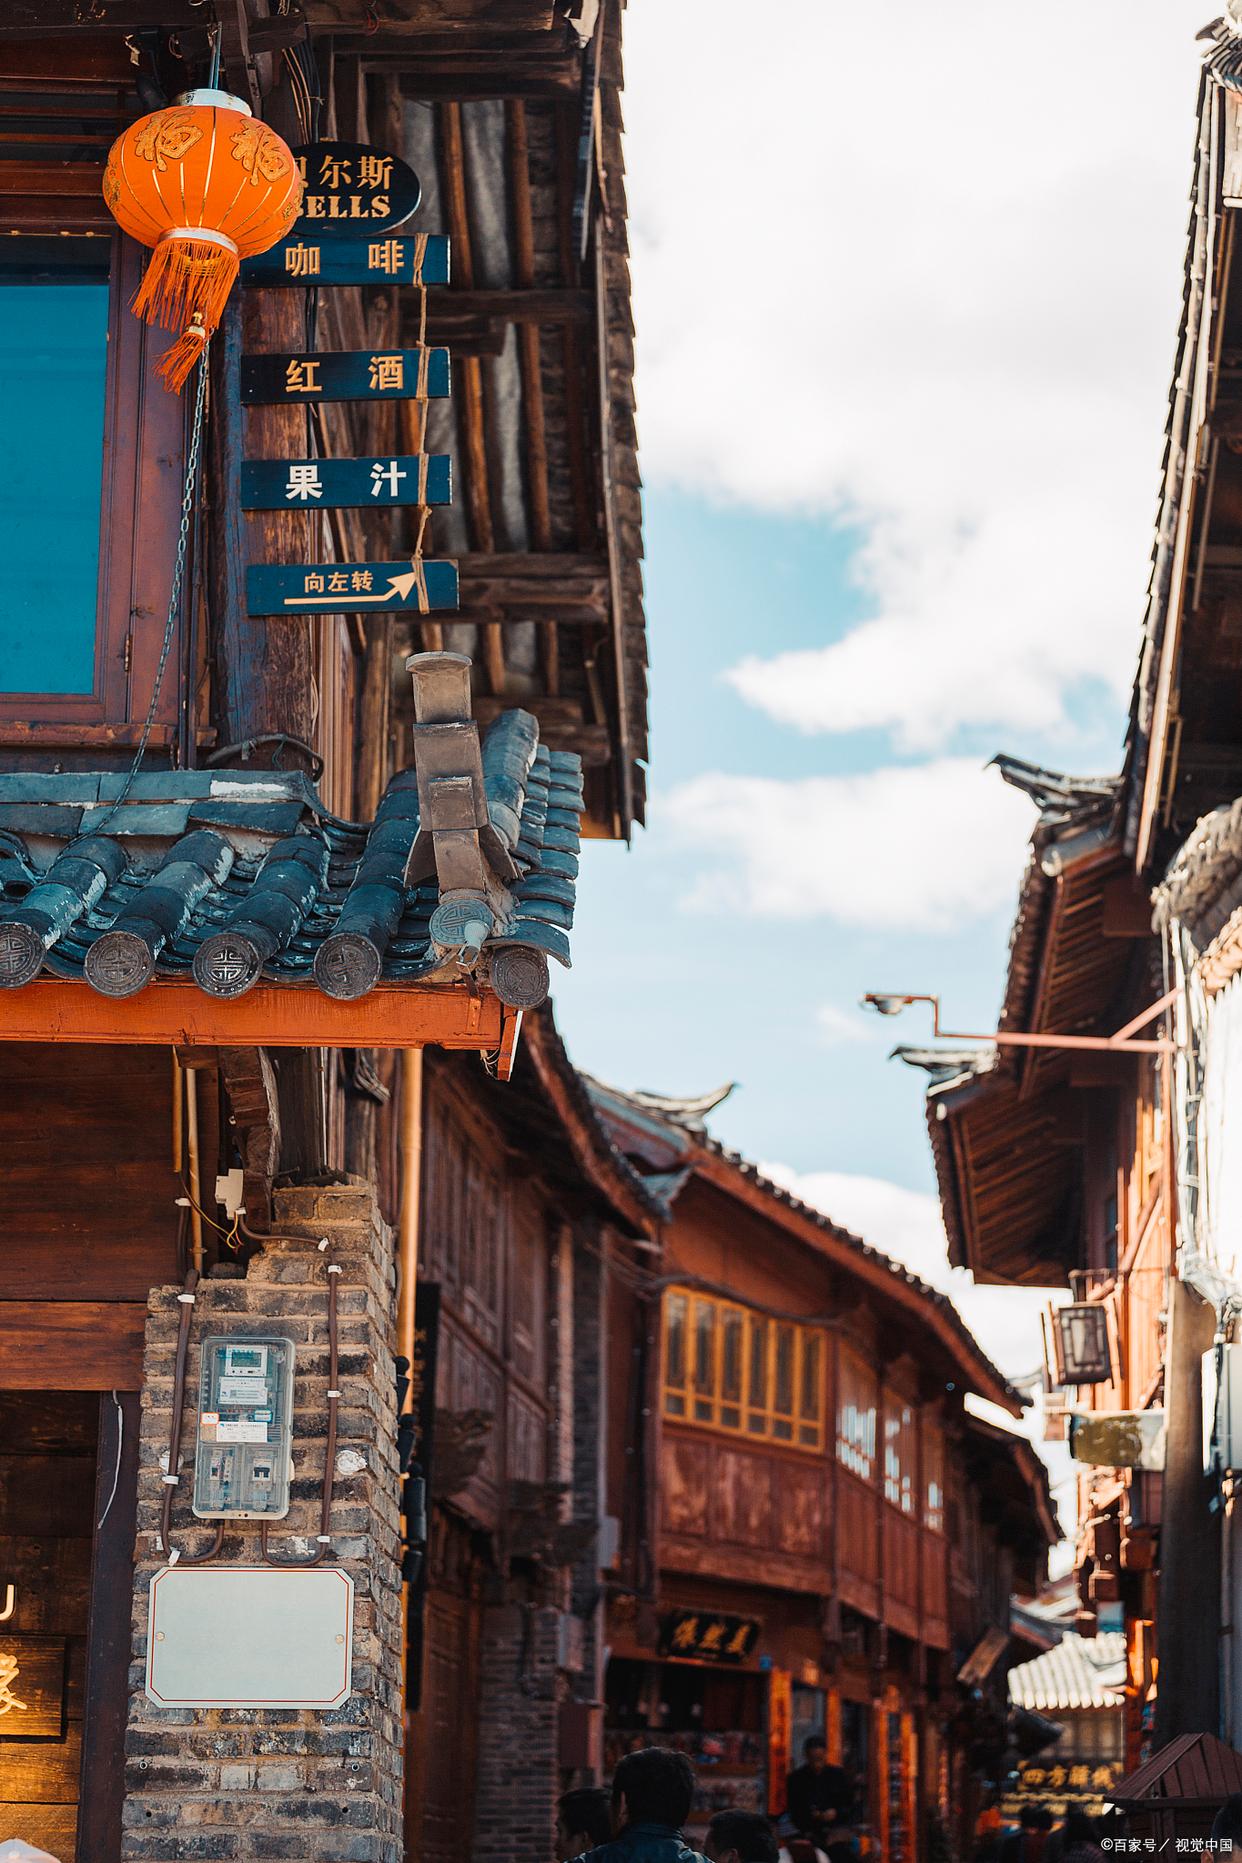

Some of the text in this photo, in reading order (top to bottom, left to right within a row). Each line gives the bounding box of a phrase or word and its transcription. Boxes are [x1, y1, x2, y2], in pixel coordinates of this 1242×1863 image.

[285, 240, 405, 277] 咖啡
[285, 355, 404, 393] 红酒
[285, 461, 407, 500] 果汁
[304, 570, 373, 593] 向左转
